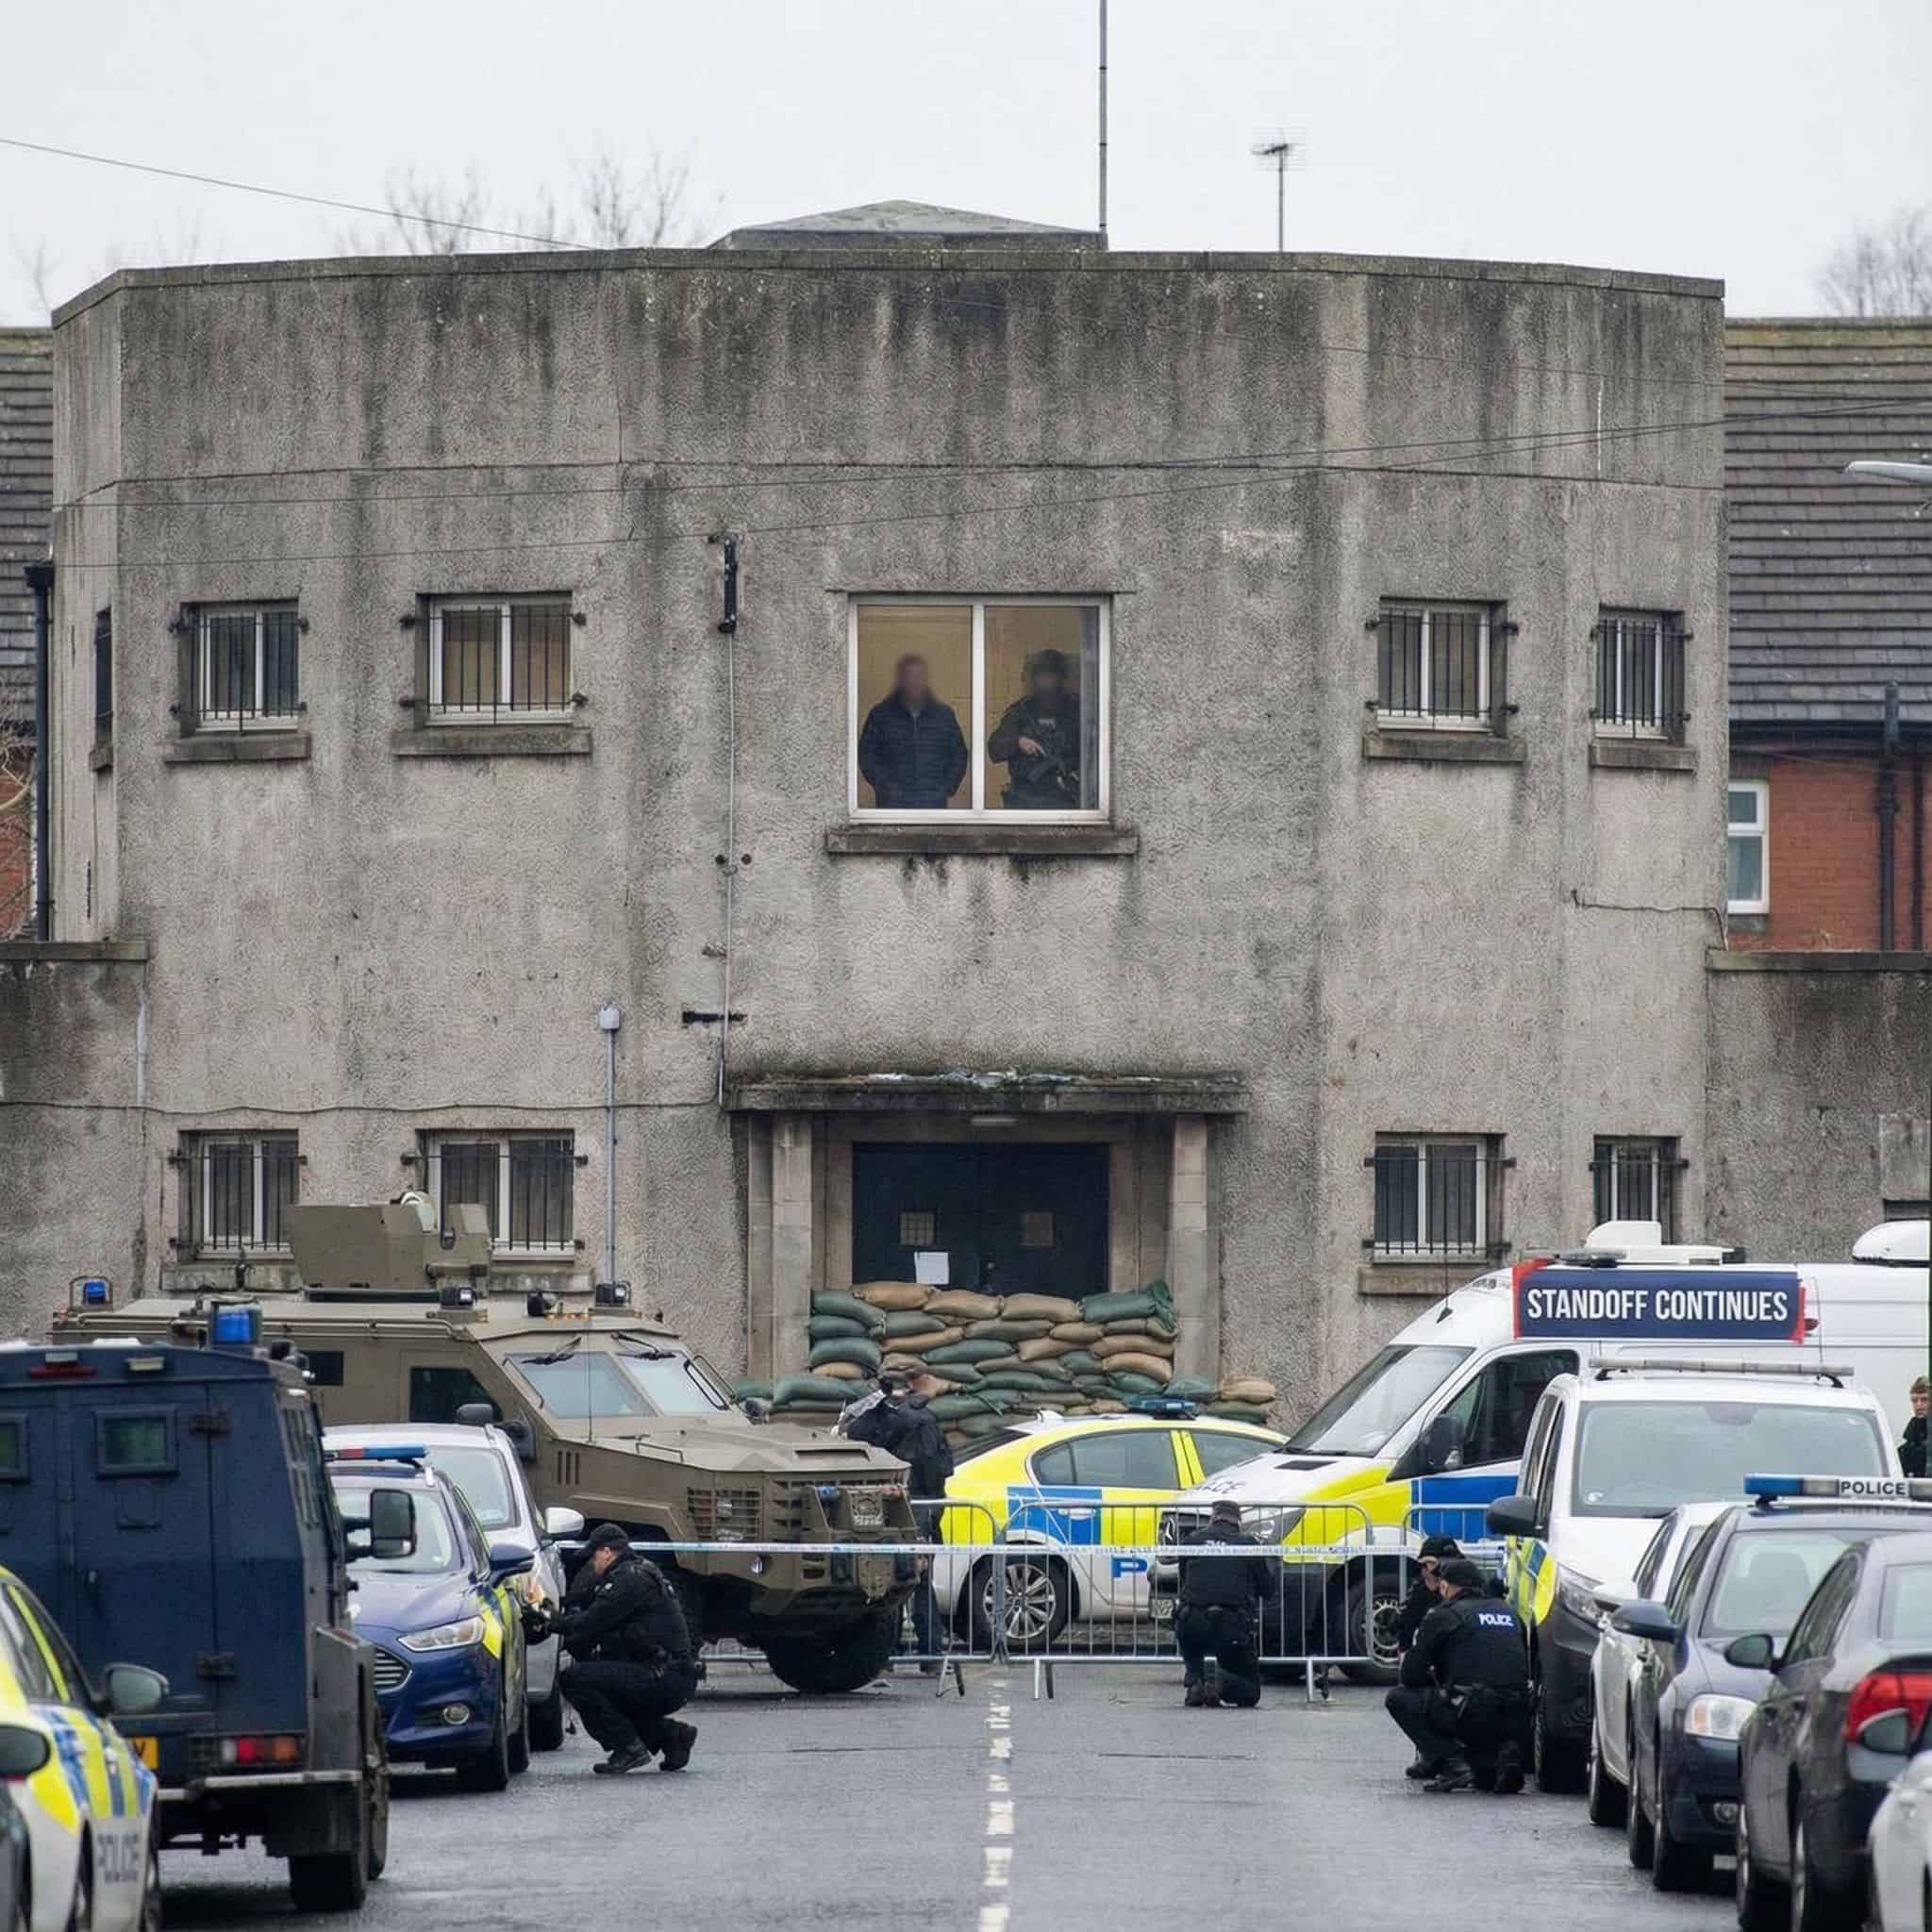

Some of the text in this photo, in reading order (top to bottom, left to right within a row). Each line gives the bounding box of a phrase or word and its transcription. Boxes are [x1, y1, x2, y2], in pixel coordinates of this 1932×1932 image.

[1527, 1288, 1789, 1322] STANDOFF CONTINUES
[1840, 1480, 1907, 1495] POLICE
[1478, 1612, 1515, 1627] POLICE
